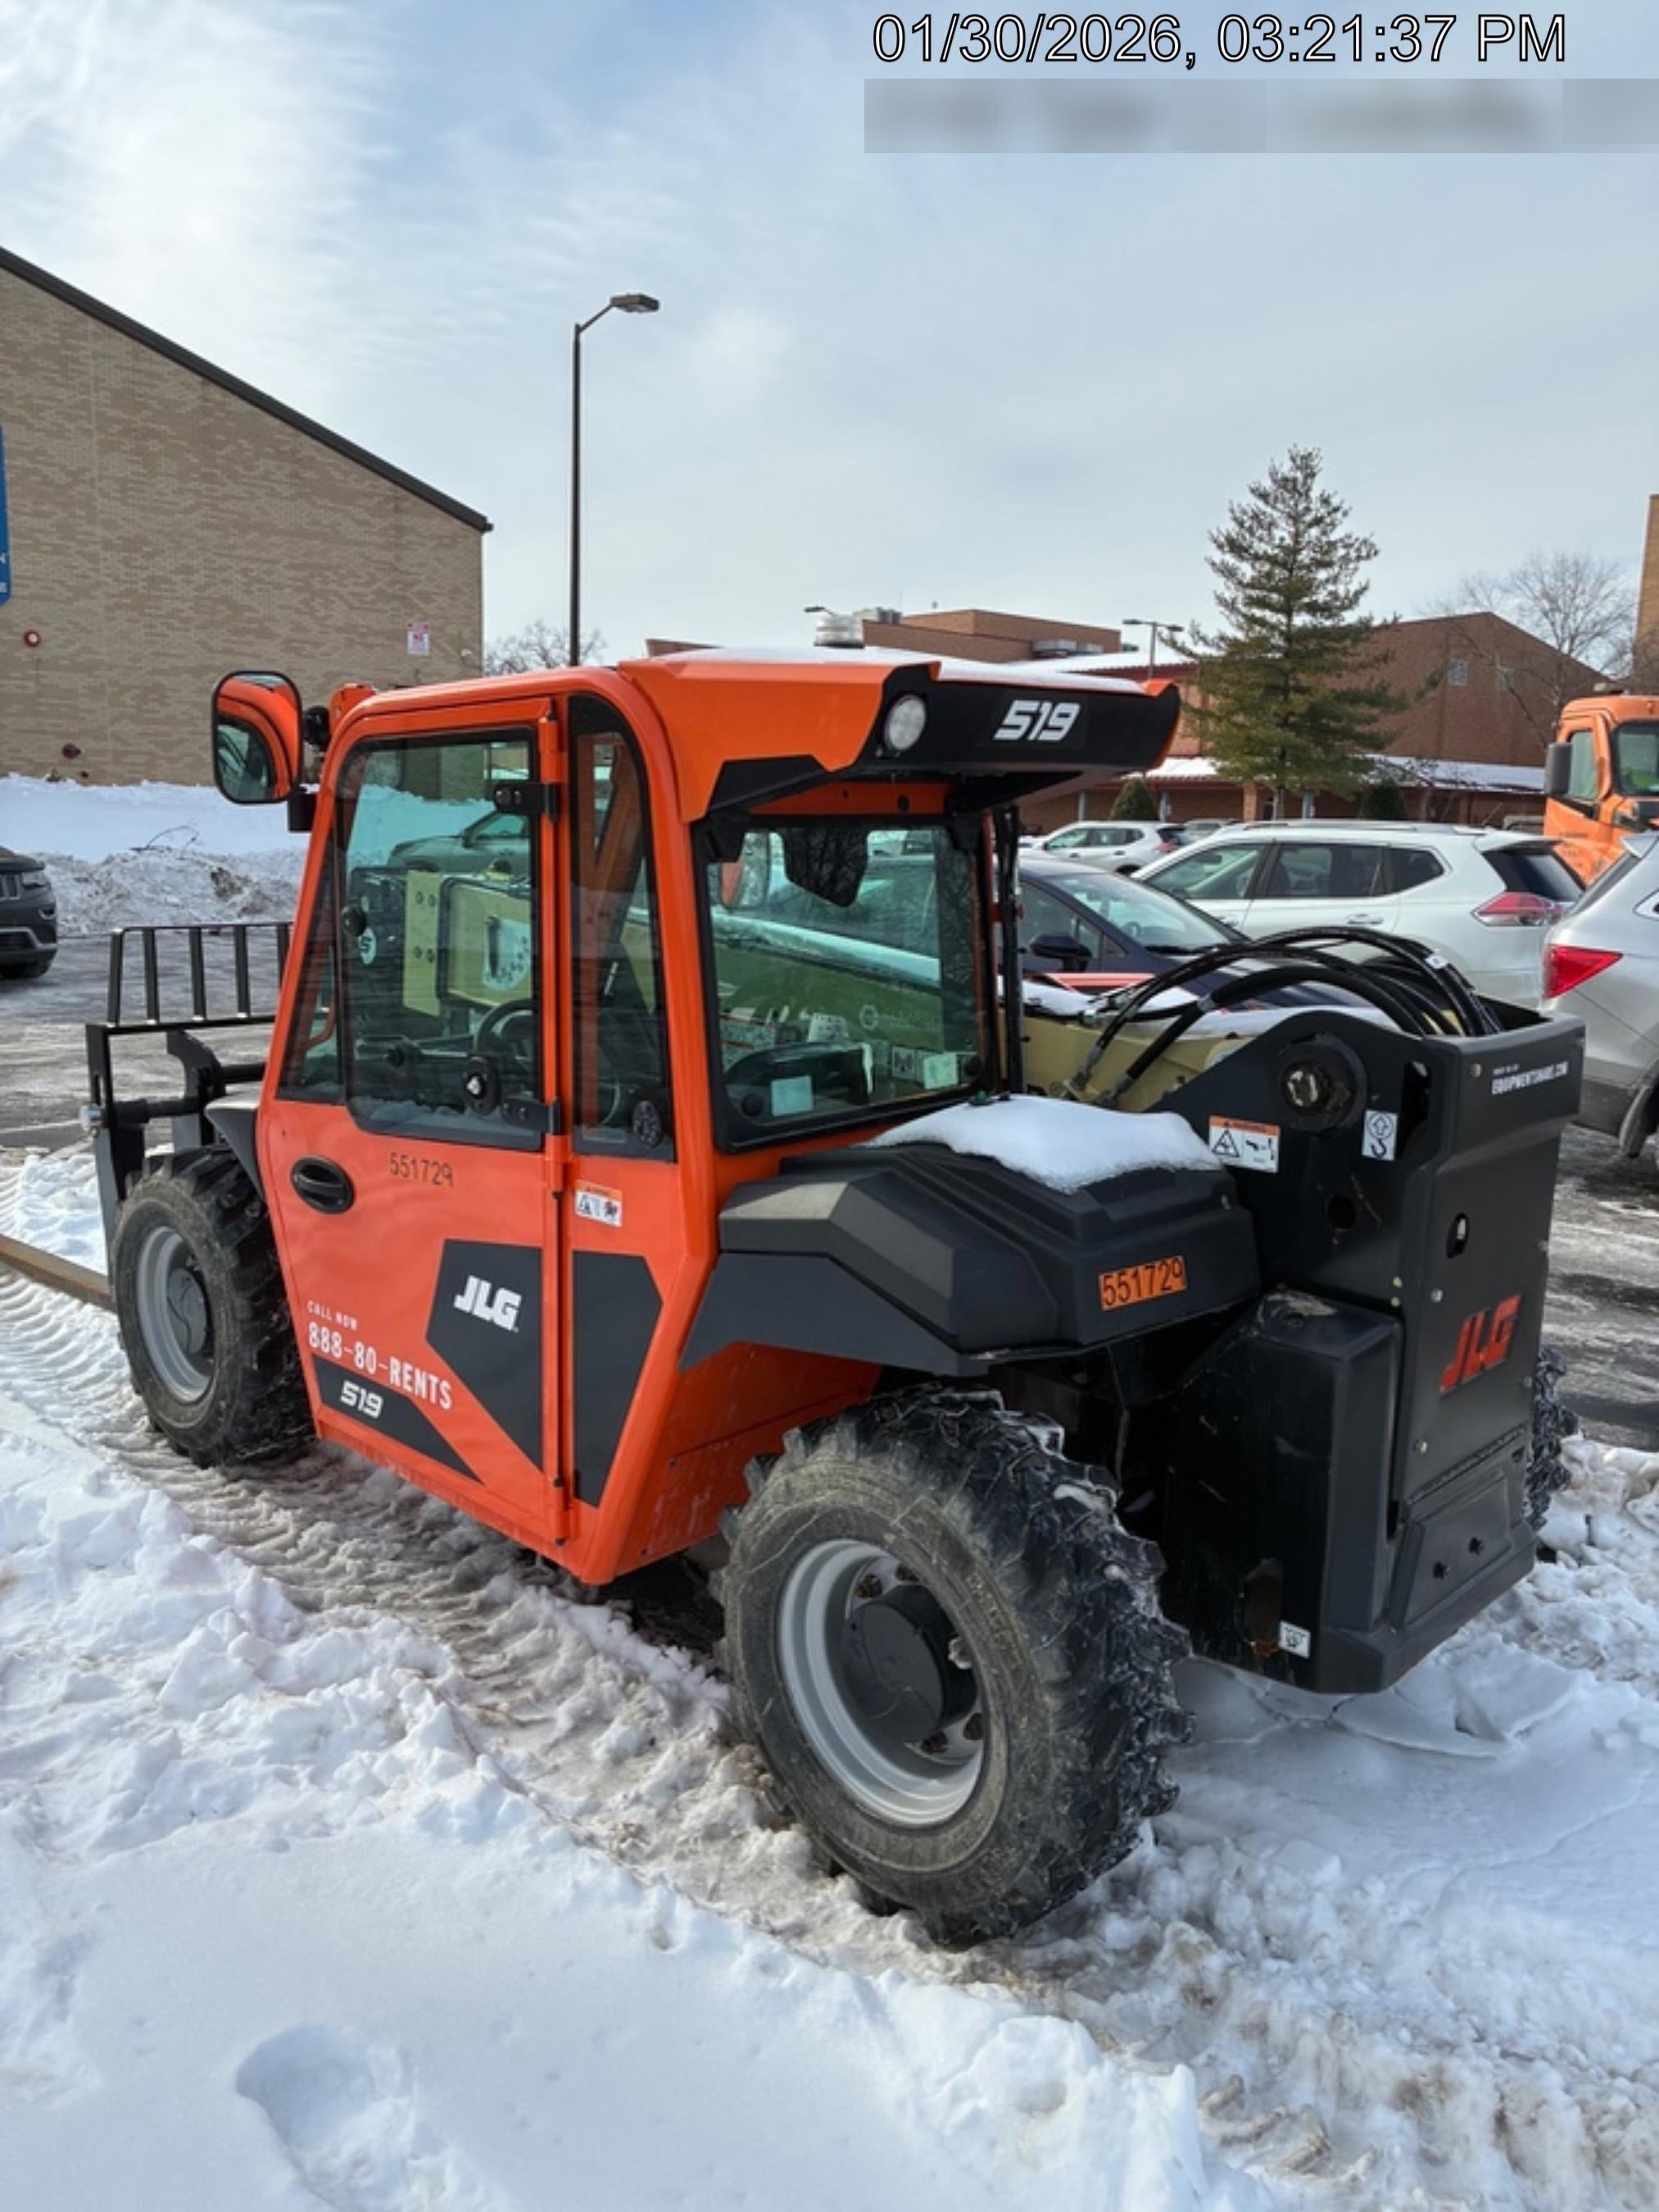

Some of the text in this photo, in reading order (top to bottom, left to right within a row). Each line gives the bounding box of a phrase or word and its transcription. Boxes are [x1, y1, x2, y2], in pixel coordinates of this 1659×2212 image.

[993, 700, 1081, 741] 519
[389, 1152, 454, 1189] 551729
[306, 1299, 358, 1330] CALL NOW
[454, 1275, 522, 1331] JLG
[1439, 1294, 1521, 1394] JLG
[308, 1321, 453, 1410] 888-80-RENTS
[339, 1380, 384, 1418] 519
